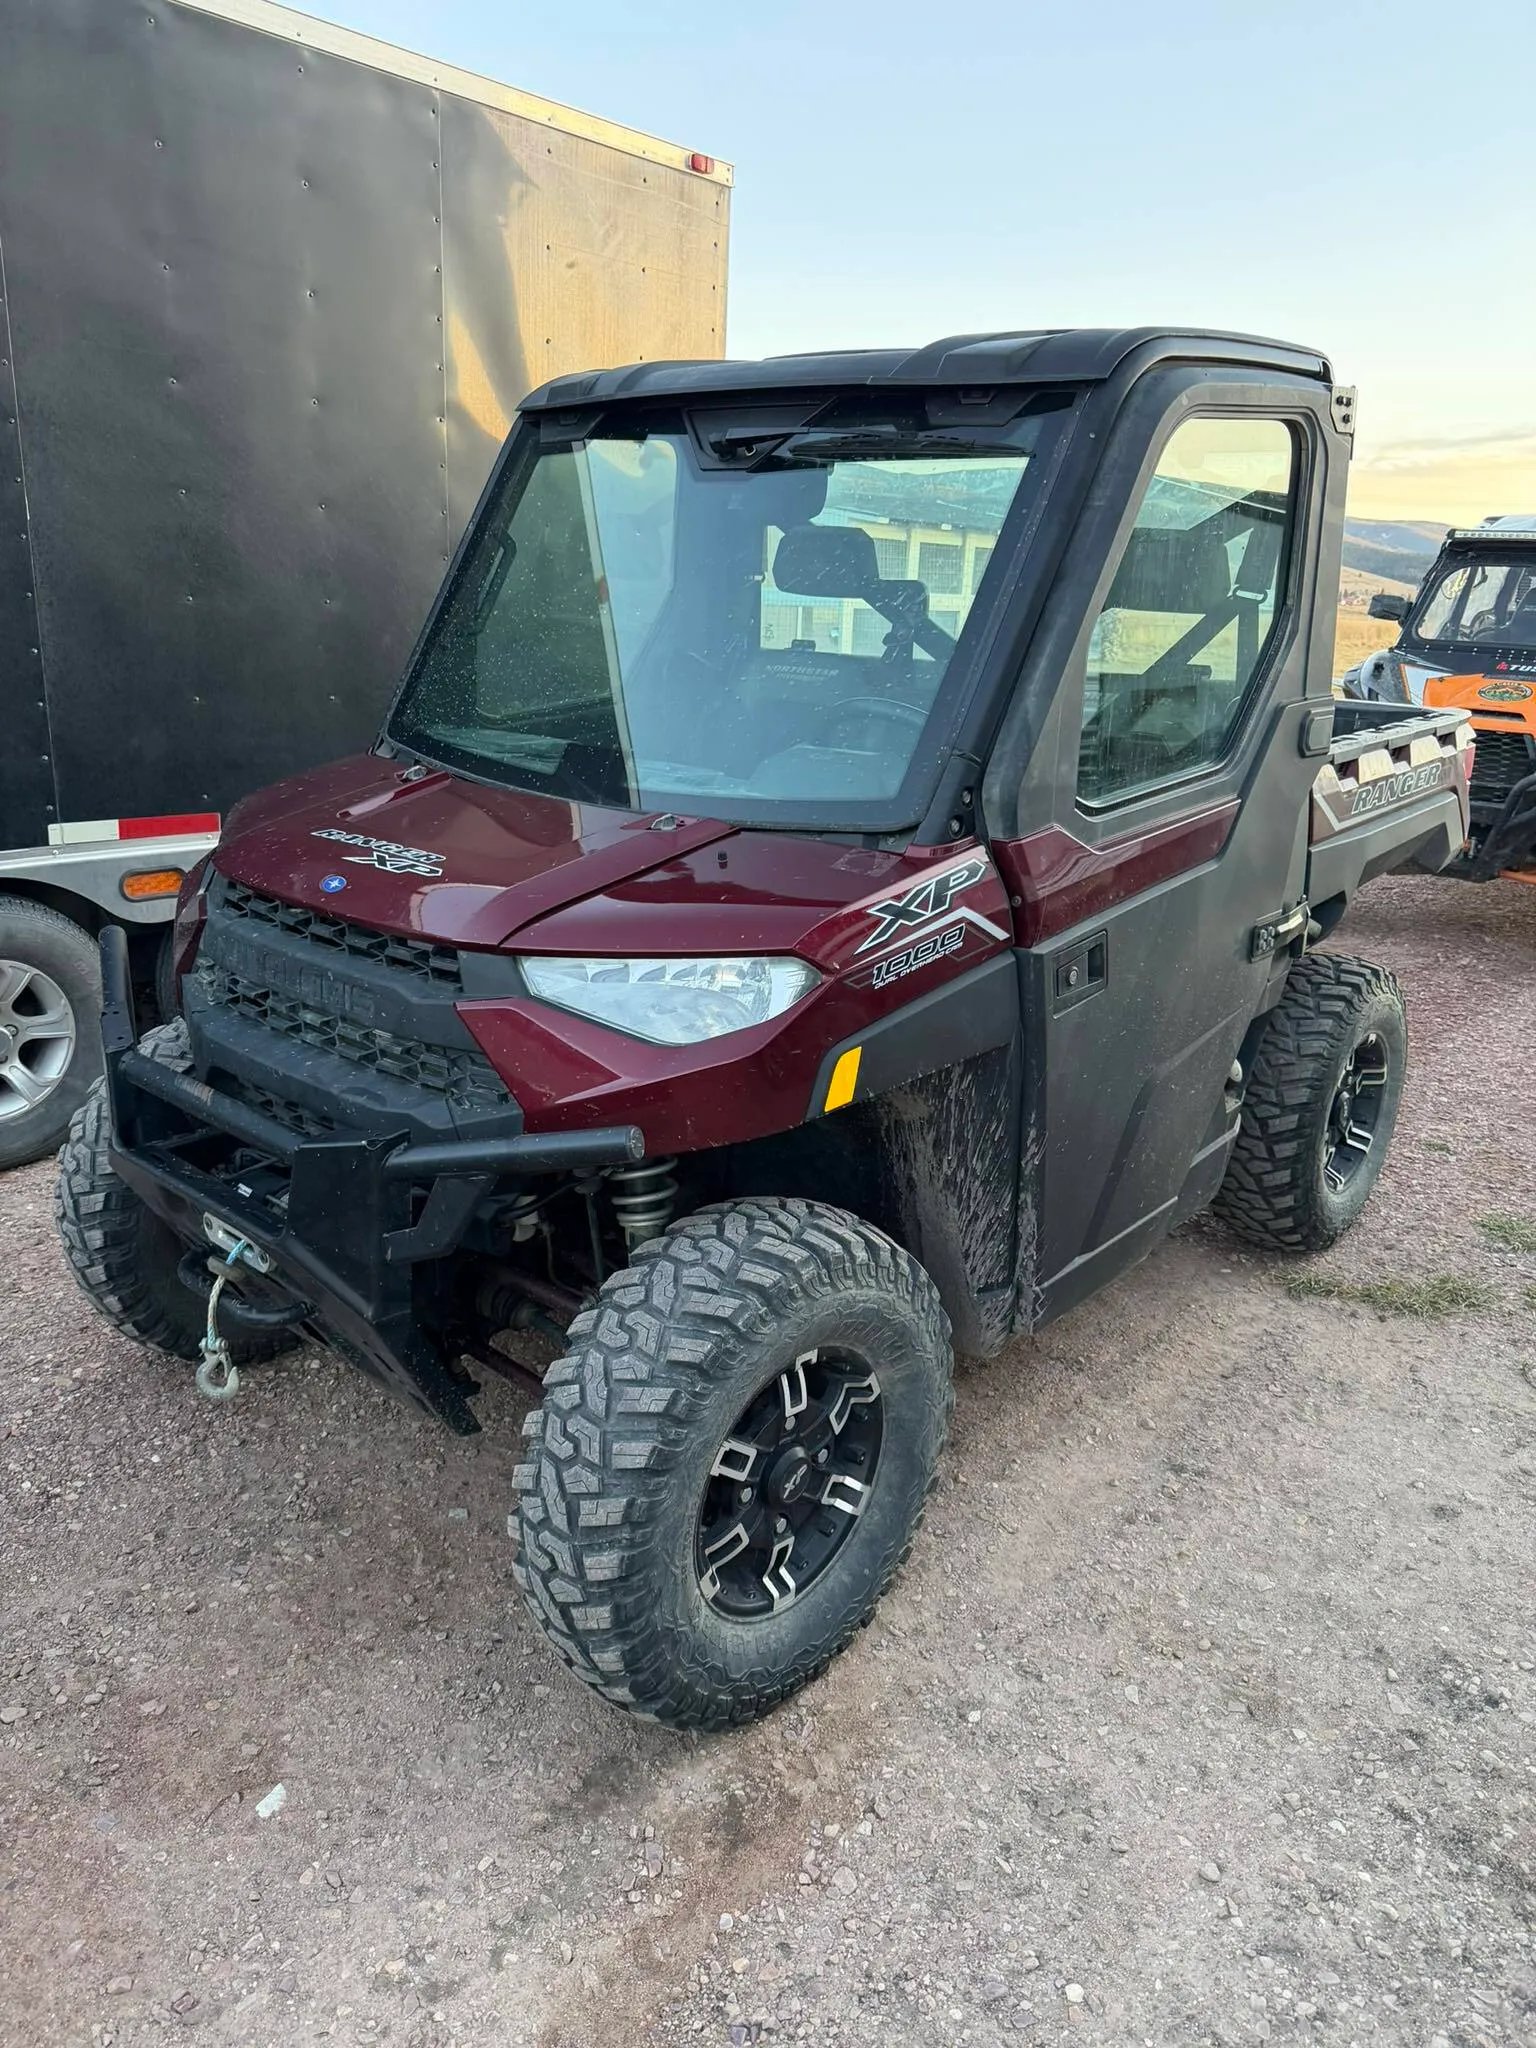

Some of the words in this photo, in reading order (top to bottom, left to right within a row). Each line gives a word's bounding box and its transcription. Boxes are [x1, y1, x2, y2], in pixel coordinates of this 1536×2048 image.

[1351, 762, 1442, 815] RANGER
[310, 828, 446, 863] RANGER
[341, 850, 443, 876] XP
[853, 858, 986, 955] XP
[872, 922, 966, 985] 1000
[874, 974, 899, 990] DUAL
